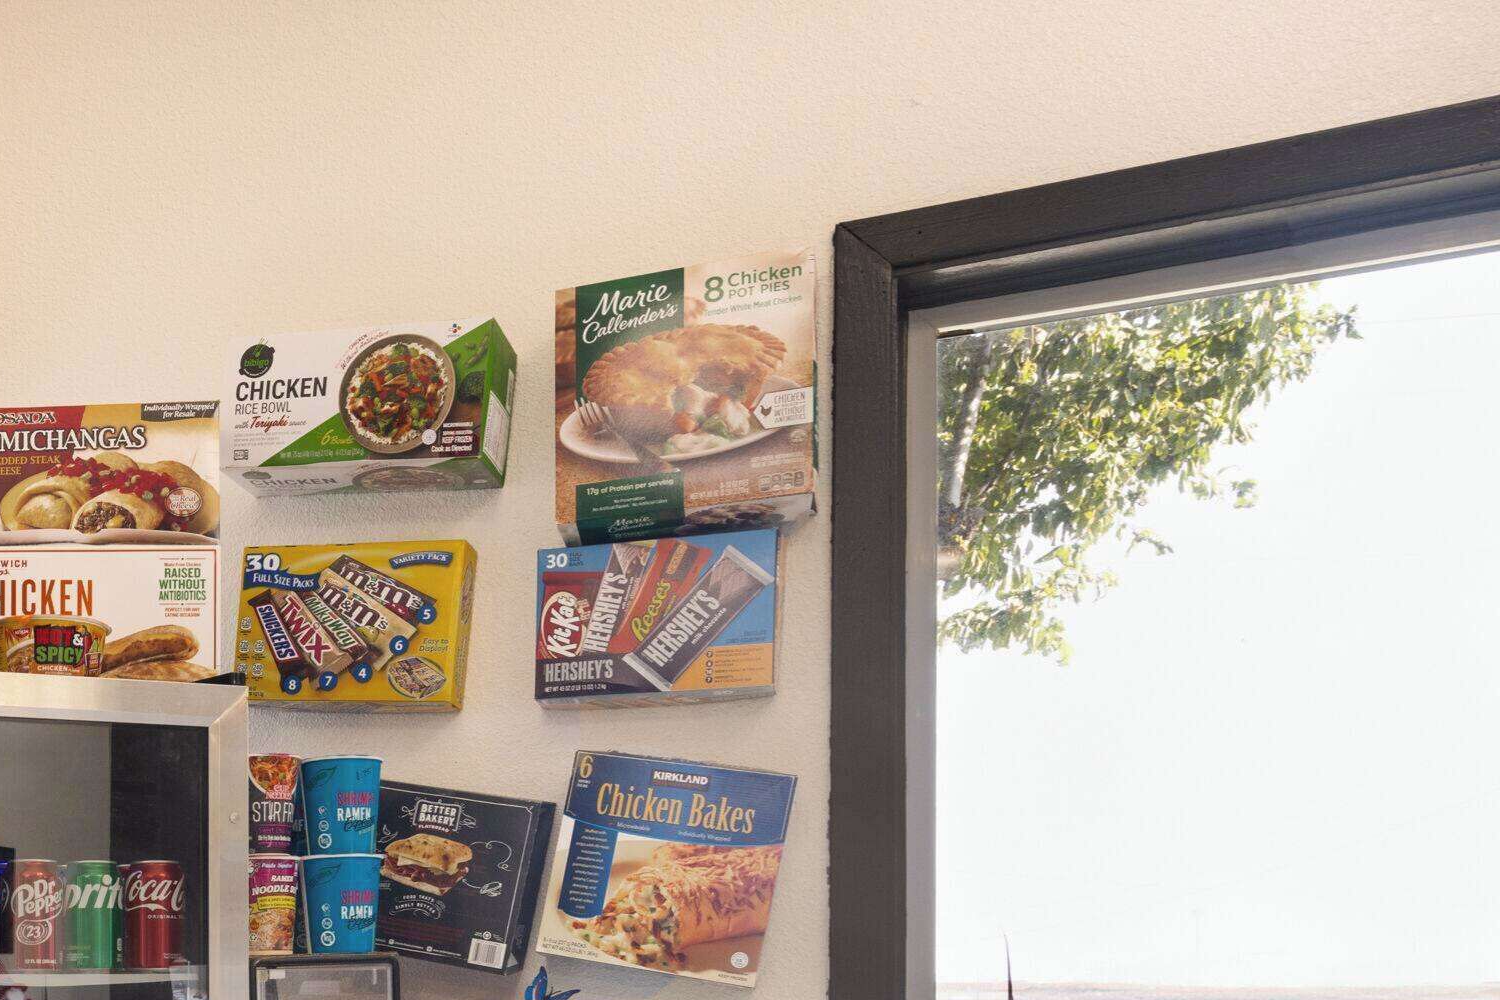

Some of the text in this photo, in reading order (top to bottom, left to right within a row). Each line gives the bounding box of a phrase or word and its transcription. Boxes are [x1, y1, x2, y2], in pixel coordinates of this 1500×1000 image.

[728, 264, 802, 288] Chicken
[704, 275, 724, 302] 8
[728, 280, 790, 300] POT PIES
[582, 283, 672, 324] Marie
[583, 303, 678, 344] Callender's
[235, 376, 328, 401] CHICKEN
[774, 391, 806, 404] CHICKEN
[144, 402, 215, 413] Individually Wrapped
[163, 410, 196, 419] for Resale
[234, 402, 292, 415] RICE BOWL
[249, 414, 289, 433] Teriyaki
[30, 455, 61, 465] STEAK
[586, 487, 599, 496] 17g
[610, 483, 634, 493] Protein
[635, 482, 647, 490] per
[648, 478, 675, 489] serving
[180, 494, 197, 503] Real
[245, 553, 280, 572] 30
[391, 552, 449, 566] VARIETY PACK
[546, 553, 568, 569] 30
[164, 568, 201, 578] RAISED
[253, 573, 315, 588] FULL SIZE PACKS
[159, 579, 206, 590] WITHOUT
[159, 590, 206, 601] ANTIBIOTICS
[422, 609, 432, 619] 5
[585, 572, 628, 653] HERSHEY'S
[631, 578, 671, 642] Reese's
[307, 596, 357, 649] Milky Way
[643, 589, 722, 668] HERSHEY'S
[35, 628, 73, 647] HOT
[259, 605, 296, 659] SNICKERS
[35, 645, 84, 664] SPICY
[358, 669, 367, 678] 4
[545, 659, 614, 683] HERSHEY'S
[288, 680, 296, 689] 8
[579, 755, 594, 779] 6
[653, 770, 709, 786] KIRKLAND
[336, 791, 374, 804] SHRIMP
[252, 801, 281, 822] STIR
[420, 803, 457, 816] BETTER
[596, 782, 756, 834] Chicken Bakes
[419, 812, 455, 827] BAKERY
[419, 824, 451, 833] FLATBREAD
[34, 879, 56, 896] Dr
[124, 870, 186, 912] Coca-C
[252, 884, 288, 896] NOODLE
[341, 890, 375, 904] SHRIMP
[26, 925, 41, 938] 23
